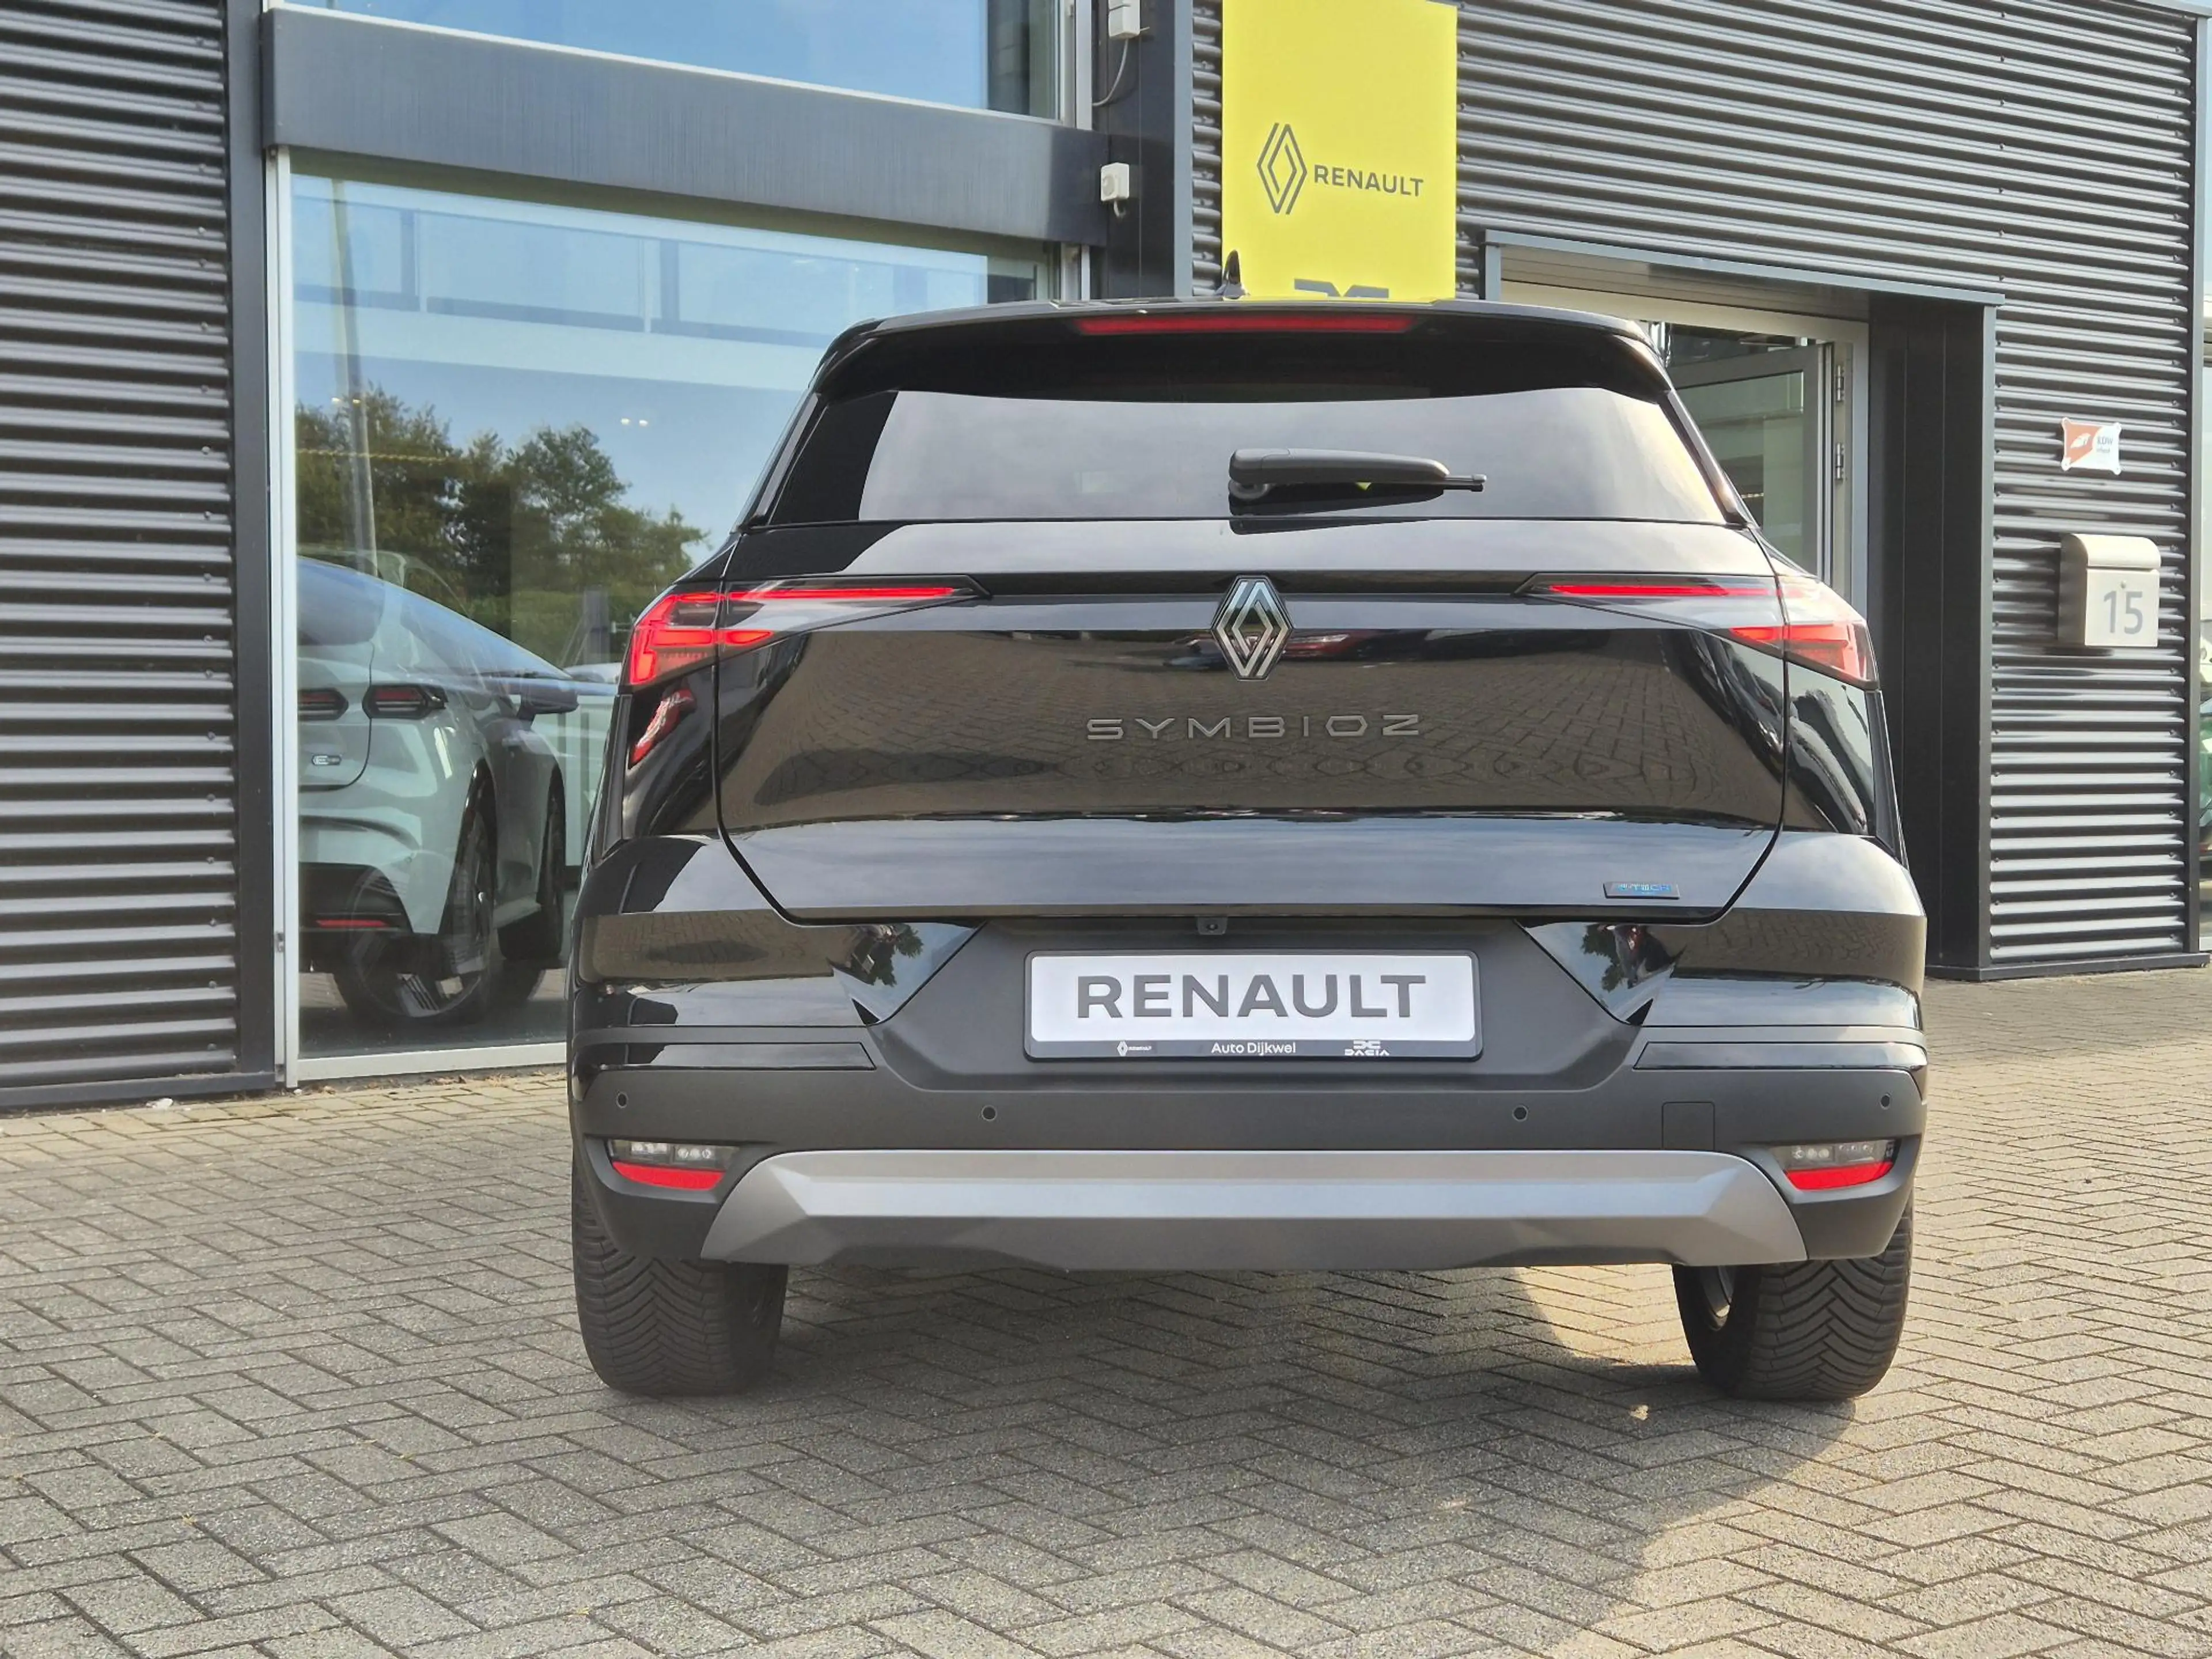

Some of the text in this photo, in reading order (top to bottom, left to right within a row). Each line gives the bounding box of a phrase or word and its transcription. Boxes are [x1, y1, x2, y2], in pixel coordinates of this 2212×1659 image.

[1314, 164, 1424, 196] RENAULT
[2103, 590, 2143, 634] 15
[1087, 714, 1419, 740] SYMBIOZ
[1077, 975, 1426, 1018] RENAULT
[1211, 1041, 1296, 1056] Auto Dijkwel
[1344, 1048, 1390, 1056] DACIA
